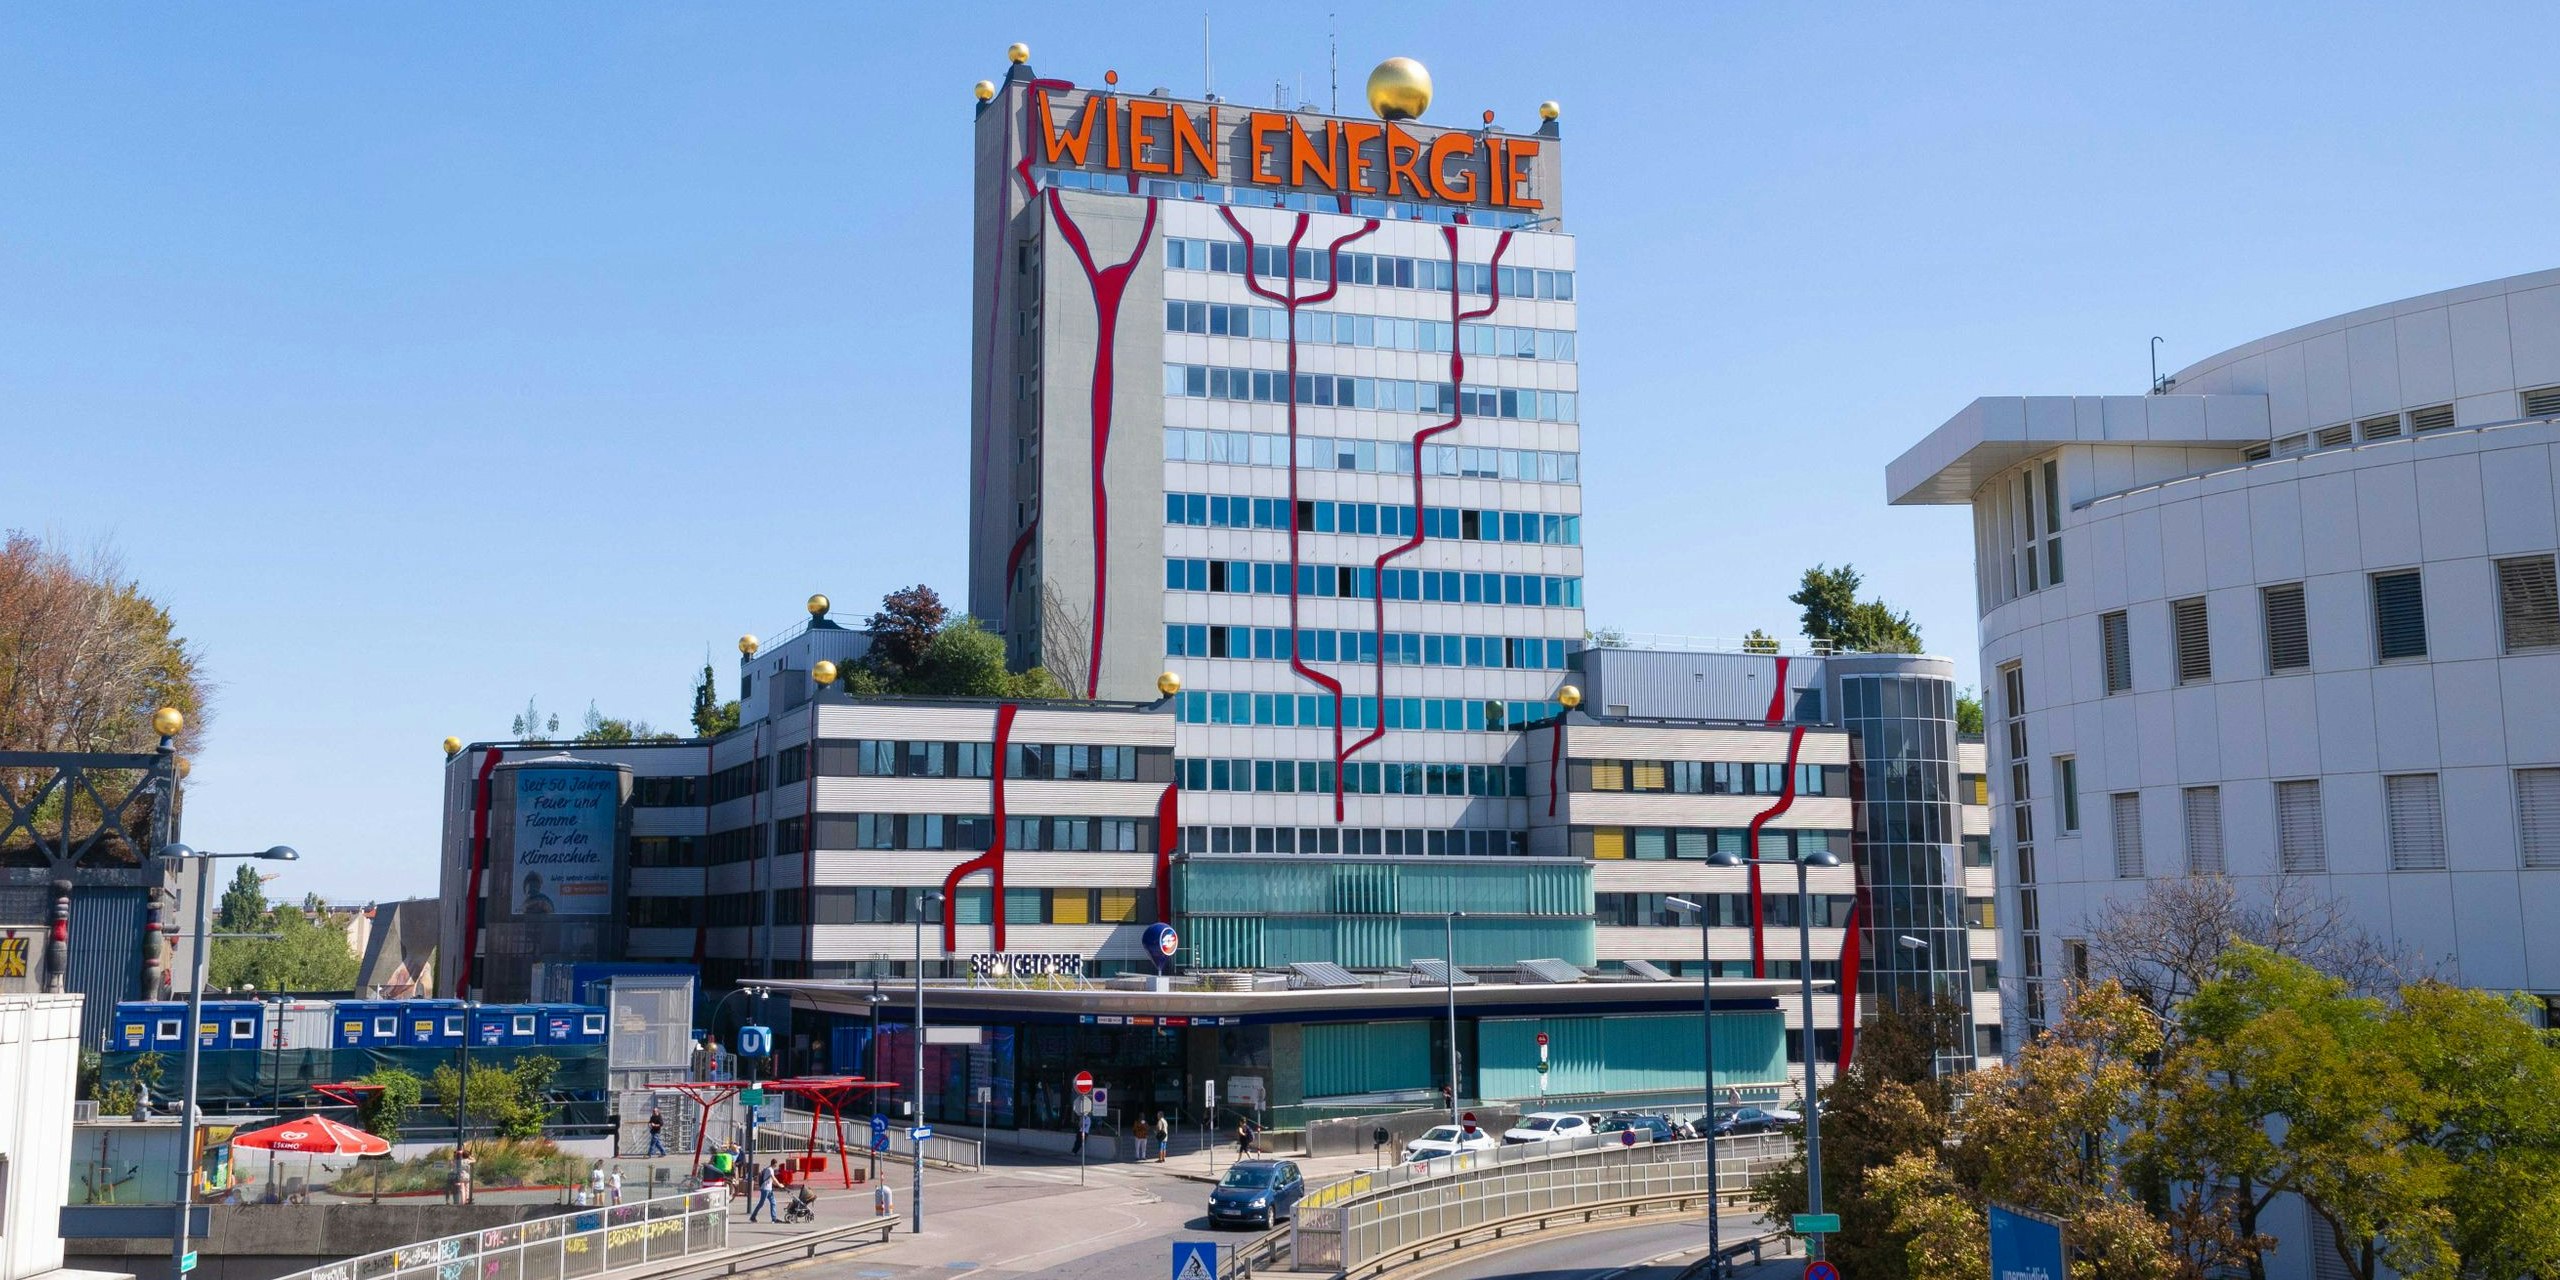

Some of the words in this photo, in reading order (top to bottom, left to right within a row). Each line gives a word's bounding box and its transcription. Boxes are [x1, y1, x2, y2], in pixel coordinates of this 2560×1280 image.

[1037, 70, 1219, 179] WIEN
[1250, 109, 1545, 210] ENERGIE
[522, 778, 547, 792] Seit
[548, 778, 567, 791] 50
[569, 776, 612, 792] Jahren
[535, 796, 569, 809] Feuer
[574, 794, 600, 809] und
[525, 813, 578, 828] Flamme
[540, 831, 560, 849] für
[563, 831, 588, 845] den
[520, 848, 600, 865] Klimaschutz.
[971, 953, 1082, 974] SERVICETREFF
[743, 1034, 760, 1053] U
[765, 1034, 772, 1053] U
